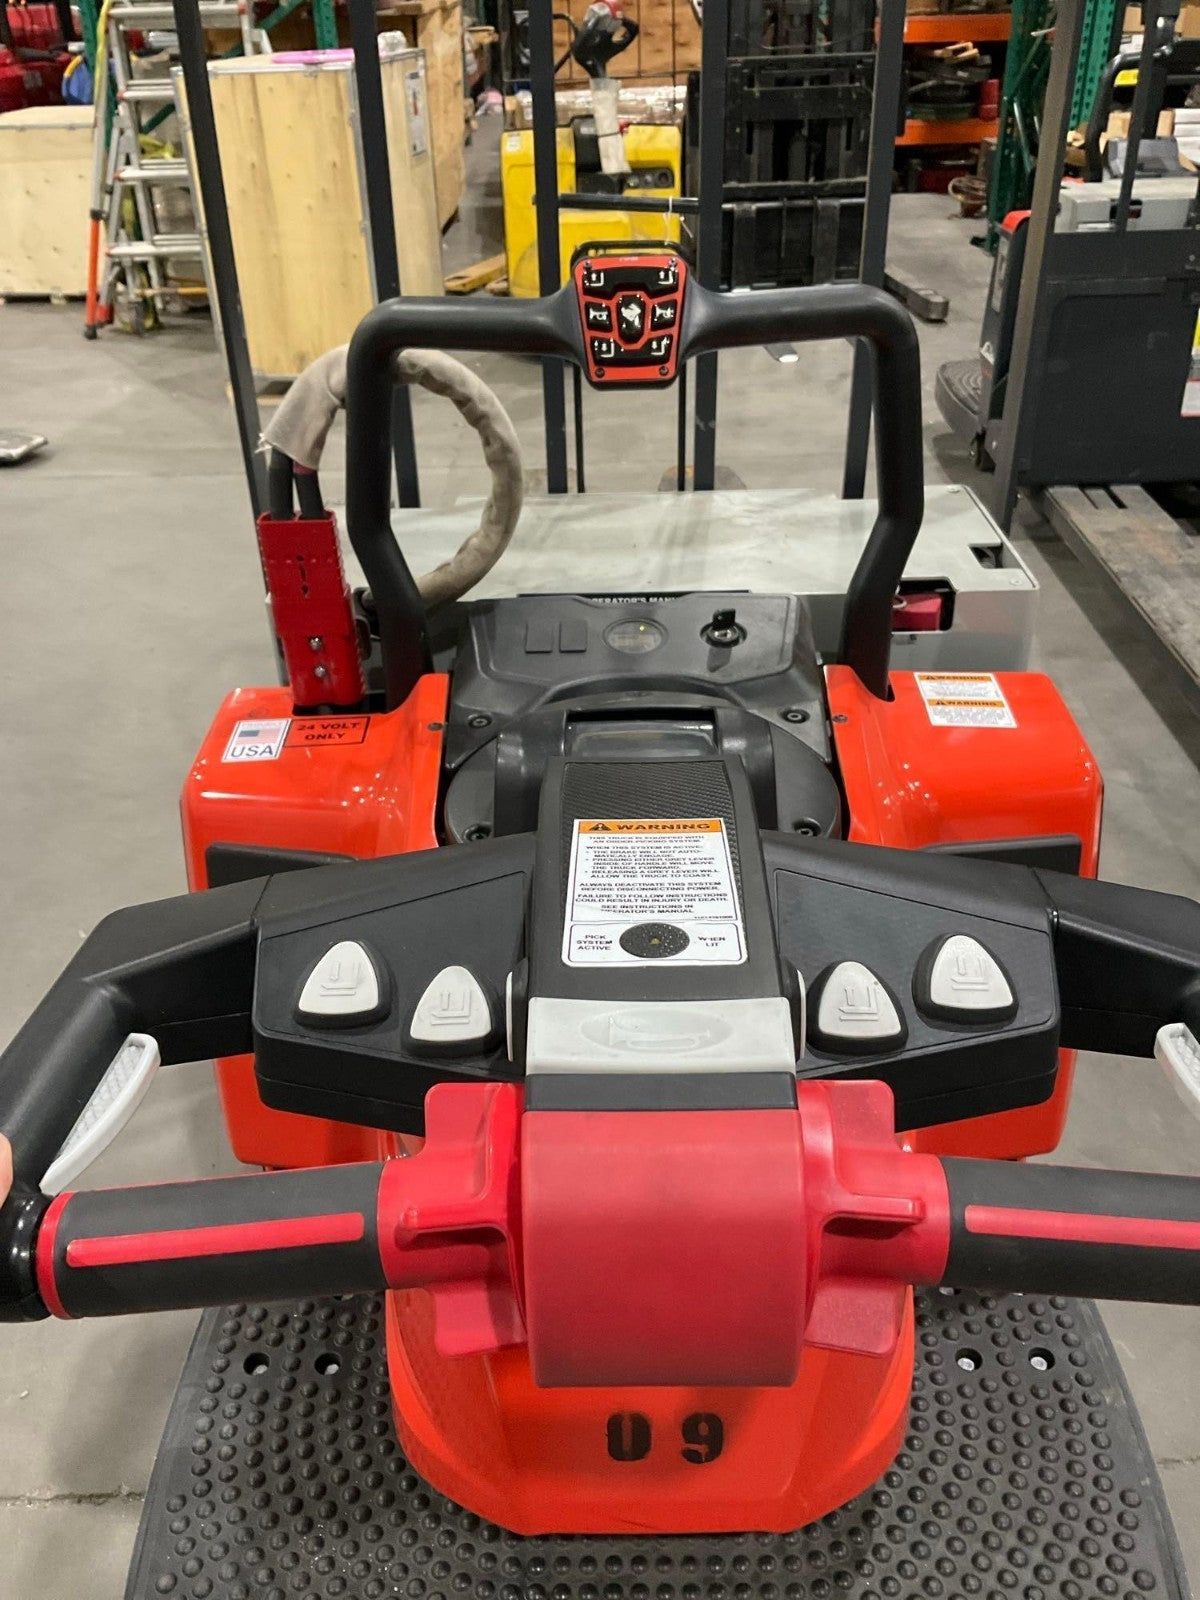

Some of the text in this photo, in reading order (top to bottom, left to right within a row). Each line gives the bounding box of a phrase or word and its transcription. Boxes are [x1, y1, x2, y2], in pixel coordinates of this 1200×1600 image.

[321, 722, 360, 730] VOLT
[304, 732, 346, 741] ONLY
[230, 745, 274, 758] USA
